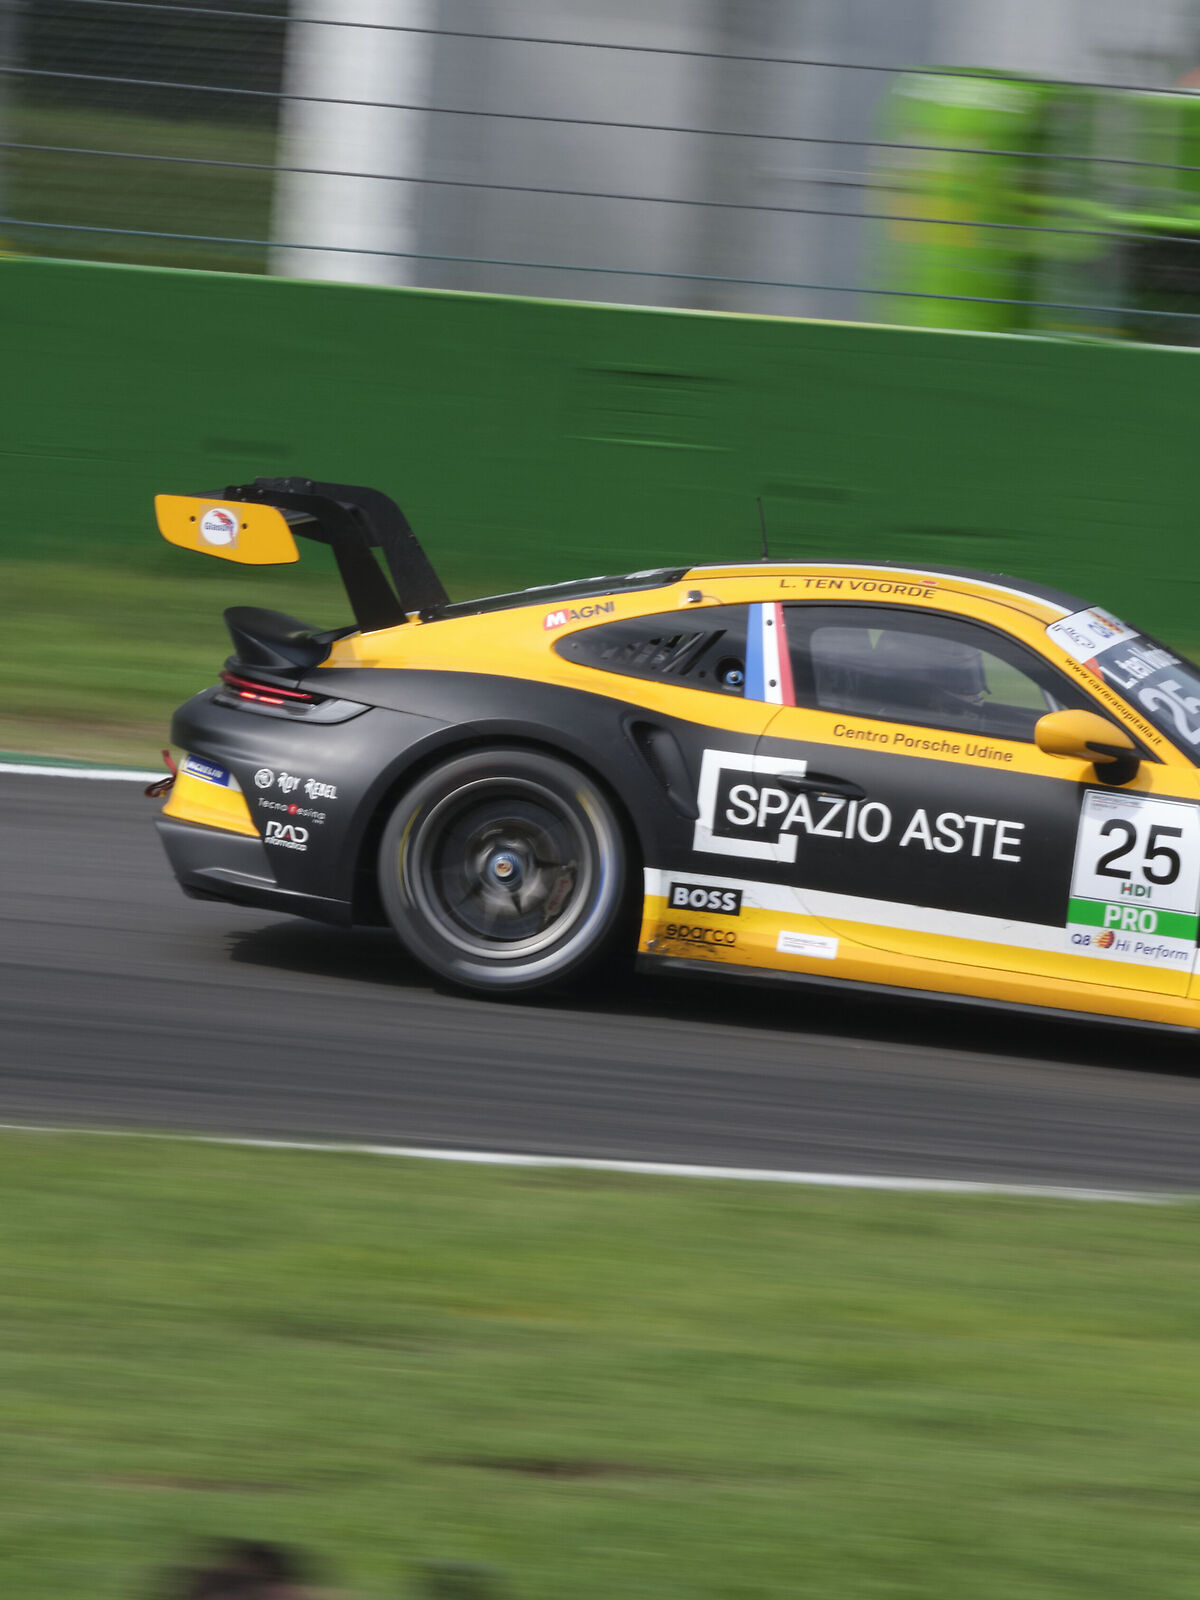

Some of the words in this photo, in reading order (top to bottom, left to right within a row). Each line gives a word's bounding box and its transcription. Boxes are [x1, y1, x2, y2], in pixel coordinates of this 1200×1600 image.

[779, 579, 796, 590] L.
[805, 578, 846, 593] TEN
[849, 580, 937, 599] VOORDE
[545, 601, 615, 628] MAGNI
[833, 723, 889, 744] Centro
[893, 732, 960, 755] Porsche
[964, 743, 1014, 763] Udine
[725, 784, 892, 843] SPAZIO
[900, 809, 1025, 863] ASTE
[1095, 818, 1182, 885] 25
[672, 886, 736, 911] BOSS
[1120, 882, 1152, 899] HDI
[1103, 904, 1158, 933] PRO
[665, 923, 737, 945] sparco
[1071, 933, 1091, 947] Q8
[1115, 939, 1130, 951] Hi
[1134, 941, 1188, 961] Perform
